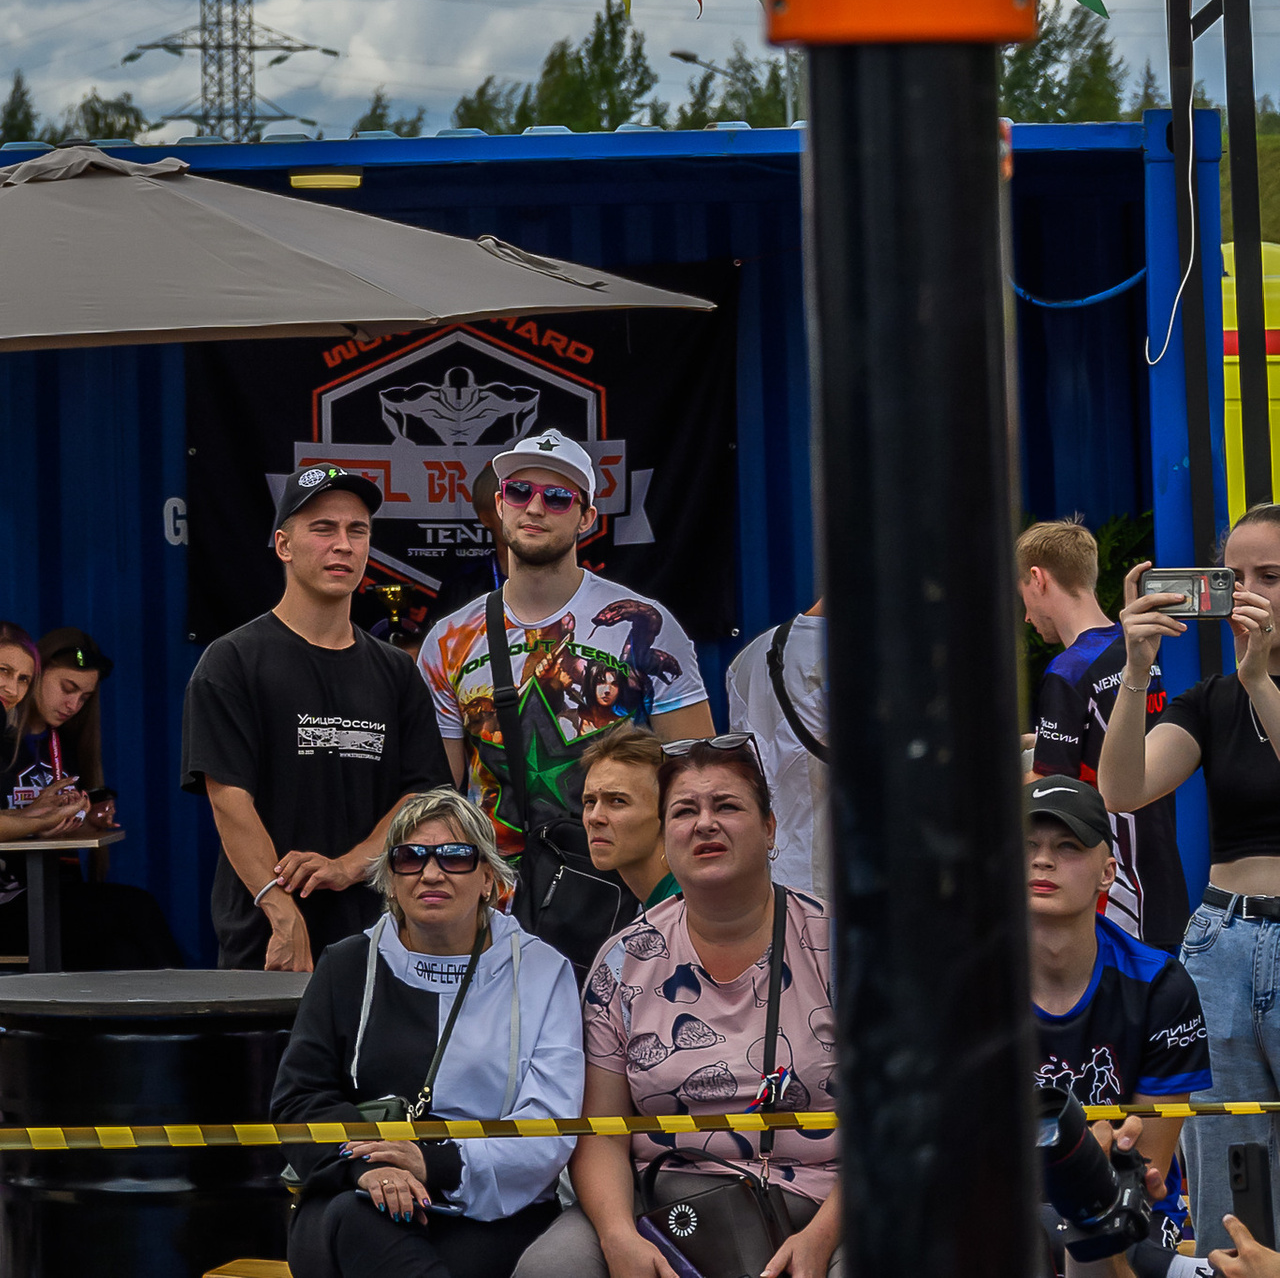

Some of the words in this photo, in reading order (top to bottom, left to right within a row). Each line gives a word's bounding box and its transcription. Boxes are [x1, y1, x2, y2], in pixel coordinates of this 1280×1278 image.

[407, 548, 448, 557] STREET
[565, 641, 631, 678] TEAM
[416, 960, 438, 983] ONE
